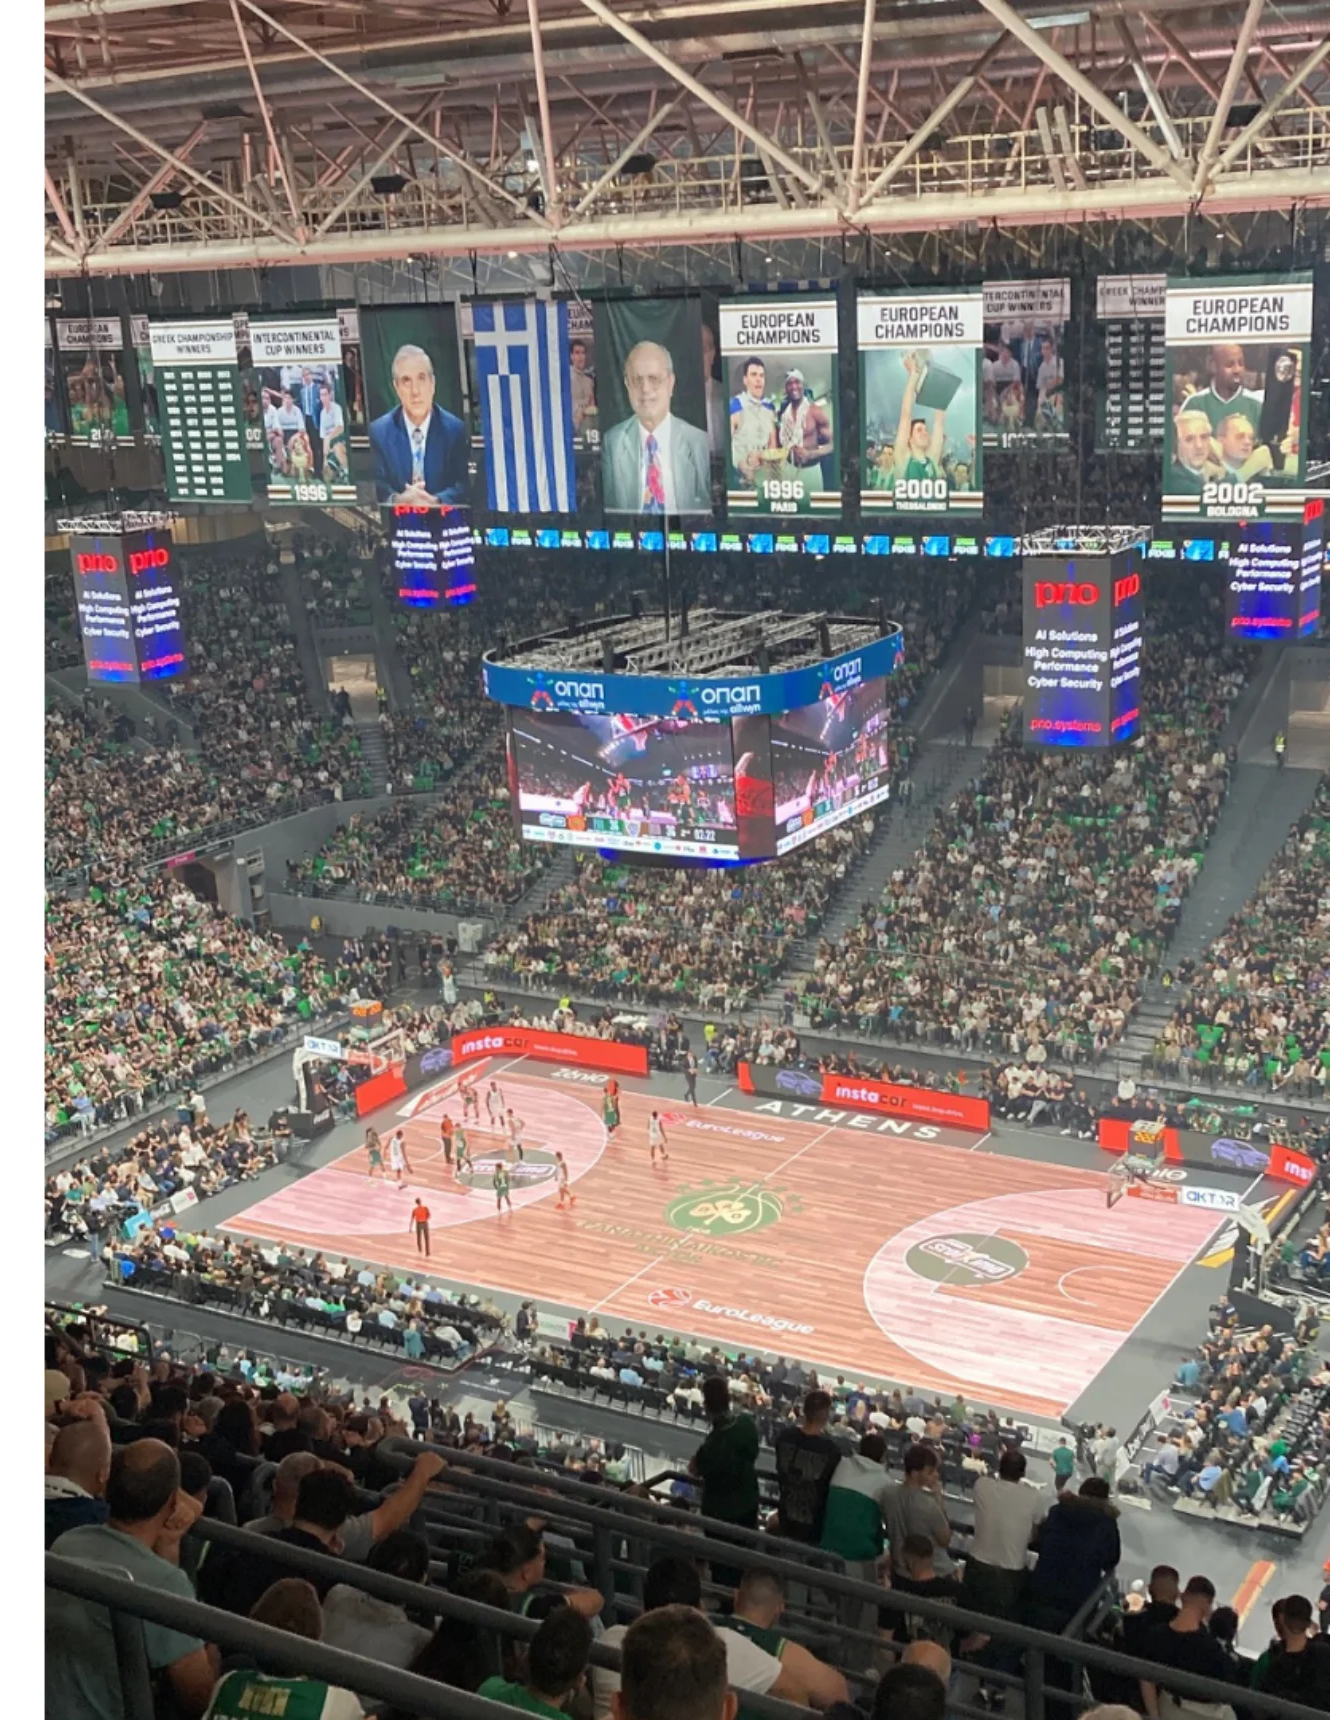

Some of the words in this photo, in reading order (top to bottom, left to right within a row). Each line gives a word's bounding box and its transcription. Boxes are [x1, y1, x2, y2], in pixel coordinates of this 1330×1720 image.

[986, 302, 1005, 313] CUP
[1007, 301, 1053, 312] WINNRS
[1129, 297, 1166, 307] WINNER
[1192, 296, 1285, 316] EUROPEAN
[741, 312, 815, 329] EUROPEAN
[880, 305, 959, 322] EUROPEAN
[875, 322, 965, 339] CHAMPIONS
[1185, 314, 1290, 334] CHAMPIONS
[152, 333, 174, 344] GREEK
[177, 332, 233, 343] CHAMPIONSHIP
[253, 330, 336, 343] INTERCONTINENTAL
[736, 328, 821, 345] CHAMPIONS
[176, 344, 211, 354] WINNERS
[265, 345, 283, 356] CUP
[285, 343, 326, 355] WINNERS
[294, 484, 328, 501] 1996
[762, 479, 804, 500] 1996
[895, 478, 947, 500] 2000
[1202, 482, 1264, 505] 2002
[770, 501, 798, 513] PARIS
[1206, 505, 1259, 518] BOLOGNA
[1237, 543, 1248, 553] AI
[1249, 543, 1292, 554] Solutions
[1228, 557, 1249, 568] High
[1251, 557, 1300, 570] Computing
[1034, 580, 1100, 608] pro
[1230, 581, 1257, 593] Cyber
[1258, 582, 1295, 594] Security
[1035, 629, 1048, 642] AI
[1048, 629, 1098, 643] Solutions
[1025, 646, 1049, 660] High
[1051, 647, 1108, 663] Computing
[1033, 660, 1099, 673] Performance
[1027, 675, 1059, 690] Cyber
[1060, 676, 1103, 692] Security
[1030, 717, 1102, 734] pro.systems
[461, 1035, 530, 1054] instacar
[835, 1082, 908, 1108] instacar
[755, 1100, 942, 1139] ATHENS
[685, 1119, 786, 1144] EuroLeague
[692, 1299, 815, 1334] EuroLeague
